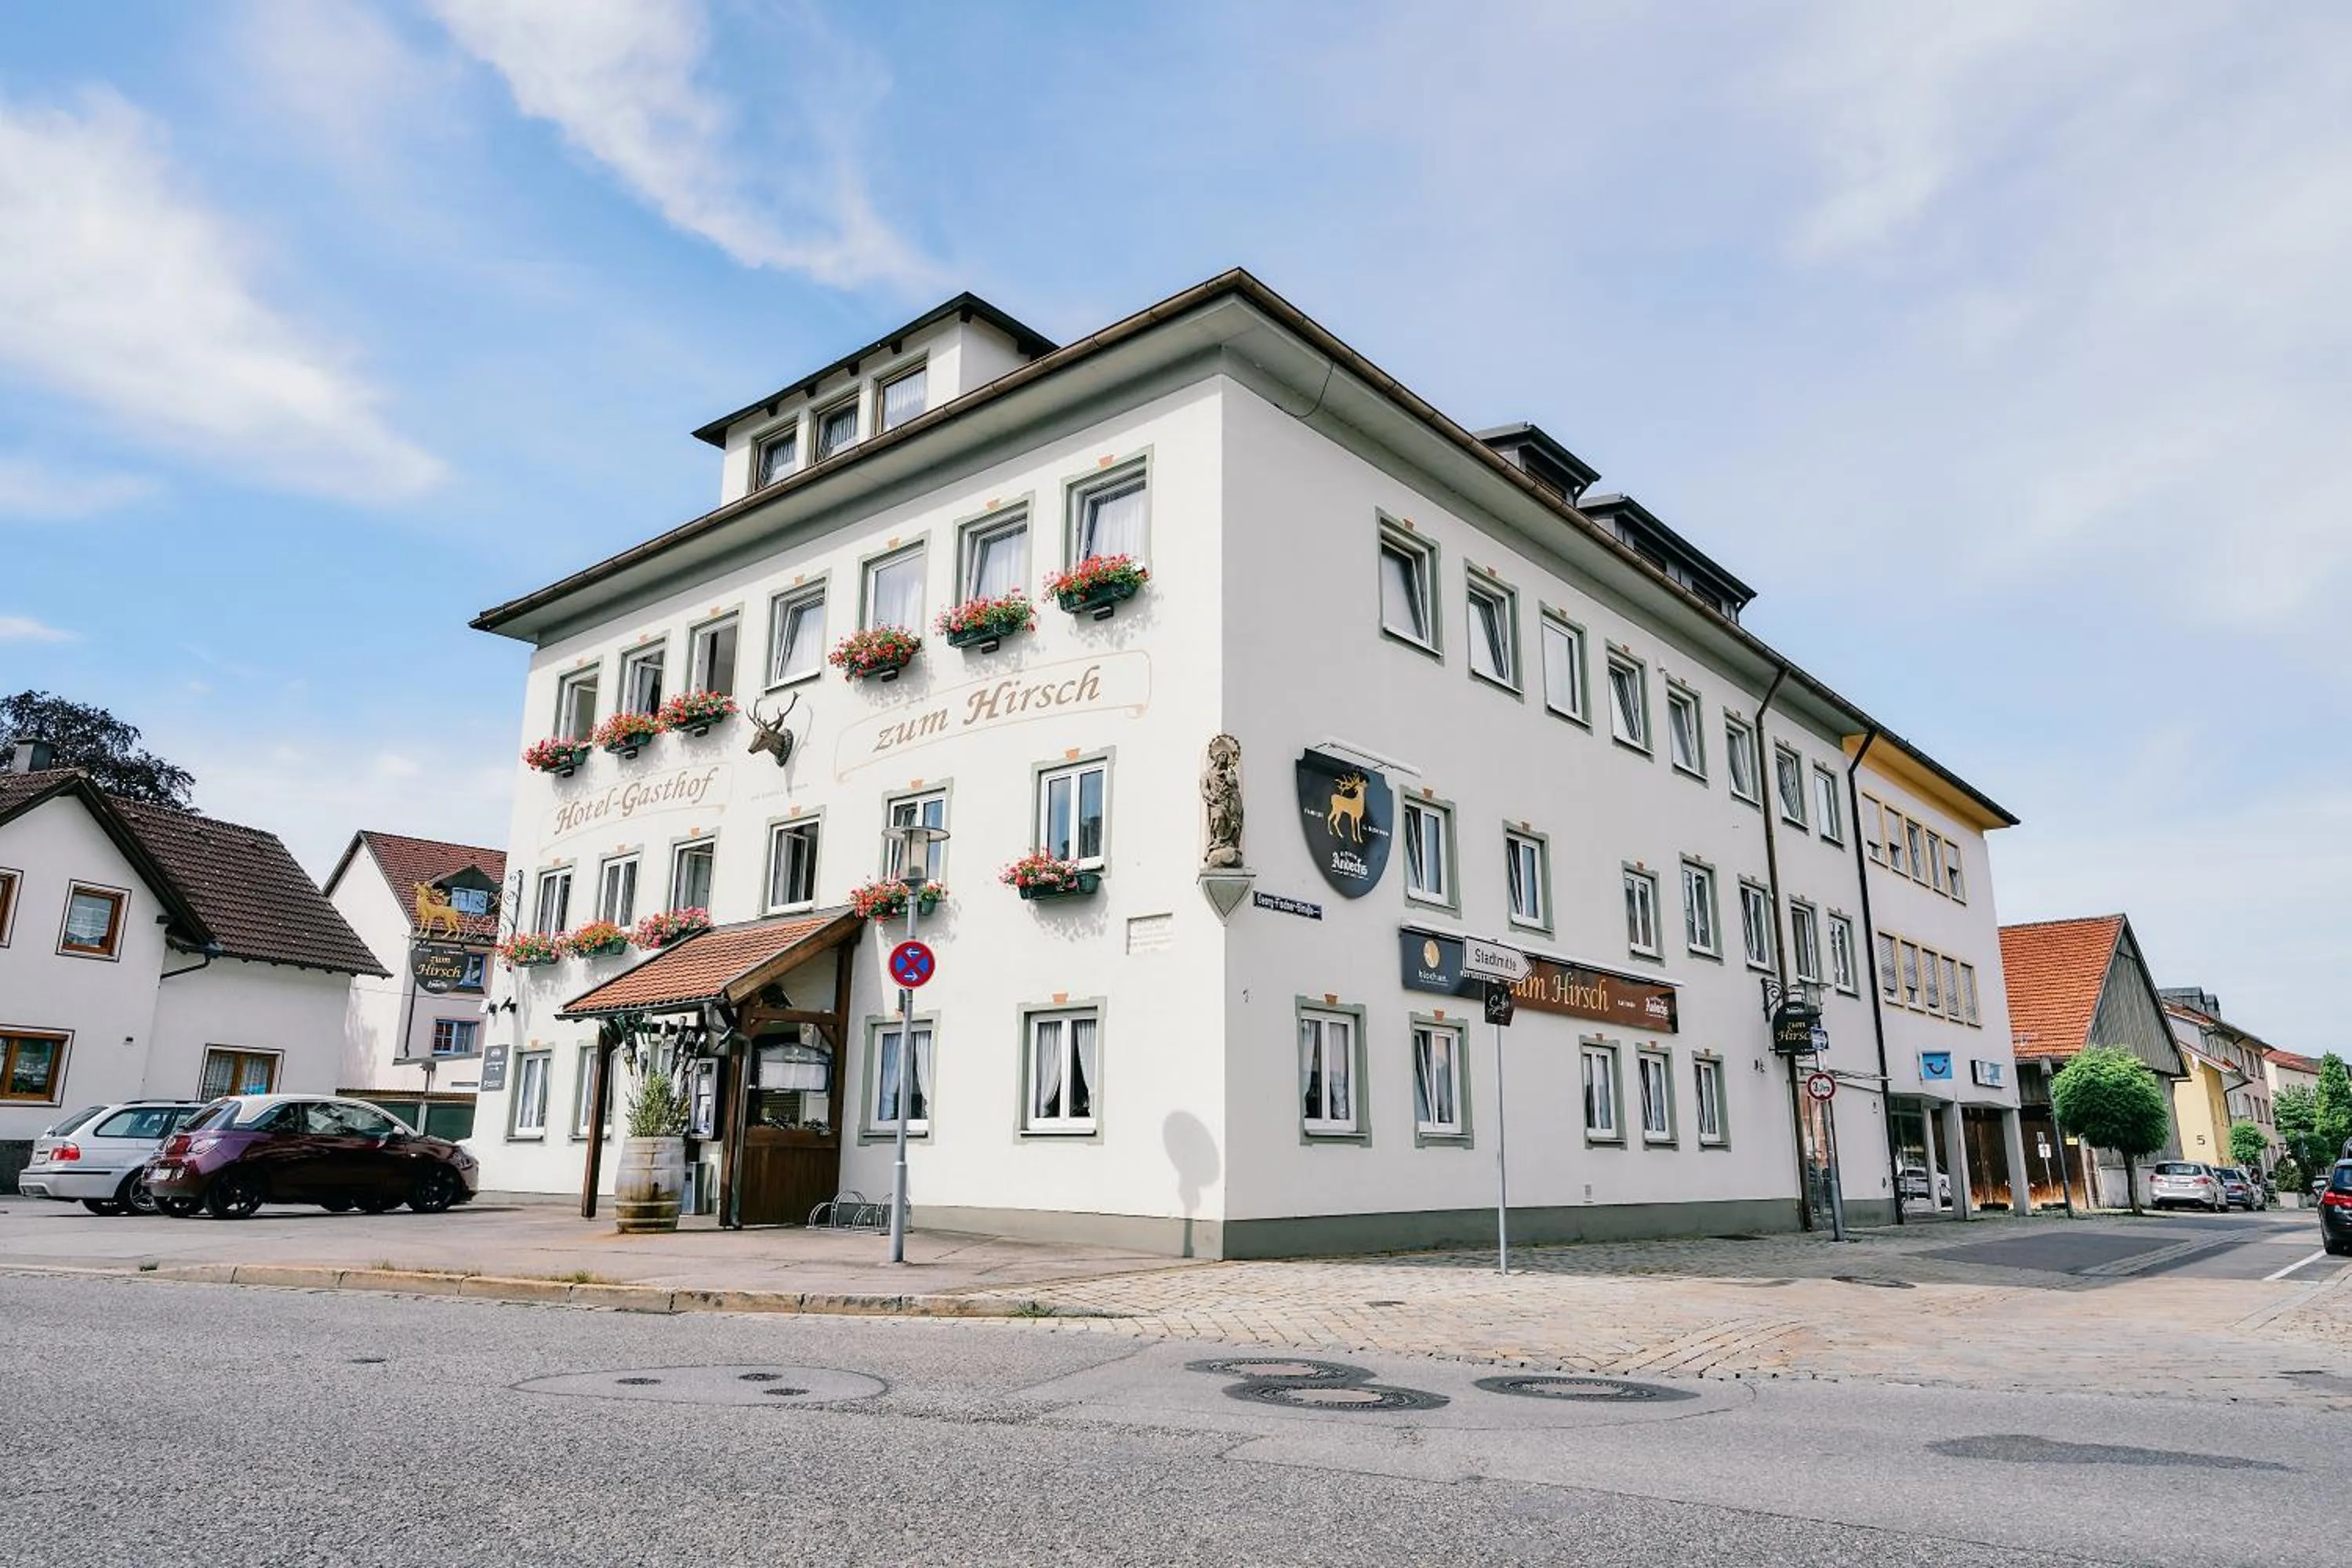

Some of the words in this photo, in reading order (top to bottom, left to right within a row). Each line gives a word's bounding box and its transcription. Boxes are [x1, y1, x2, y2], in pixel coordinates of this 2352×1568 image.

[872, 708, 949, 753] zum
[963, 665, 1101, 726] Hirsch
[554, 766, 719, 835] Hotel-Gasthof
[1475, 947, 1517, 971] Stadtmitte
[416, 964, 462, 978] Hirsch
[1552, 971, 1610, 1012] Hirsch
[1777, 1029, 1810, 1041] Hirsc
[1788, 1022, 1806, 1033] zum
[2196, 1134, 2205, 1145] 5
